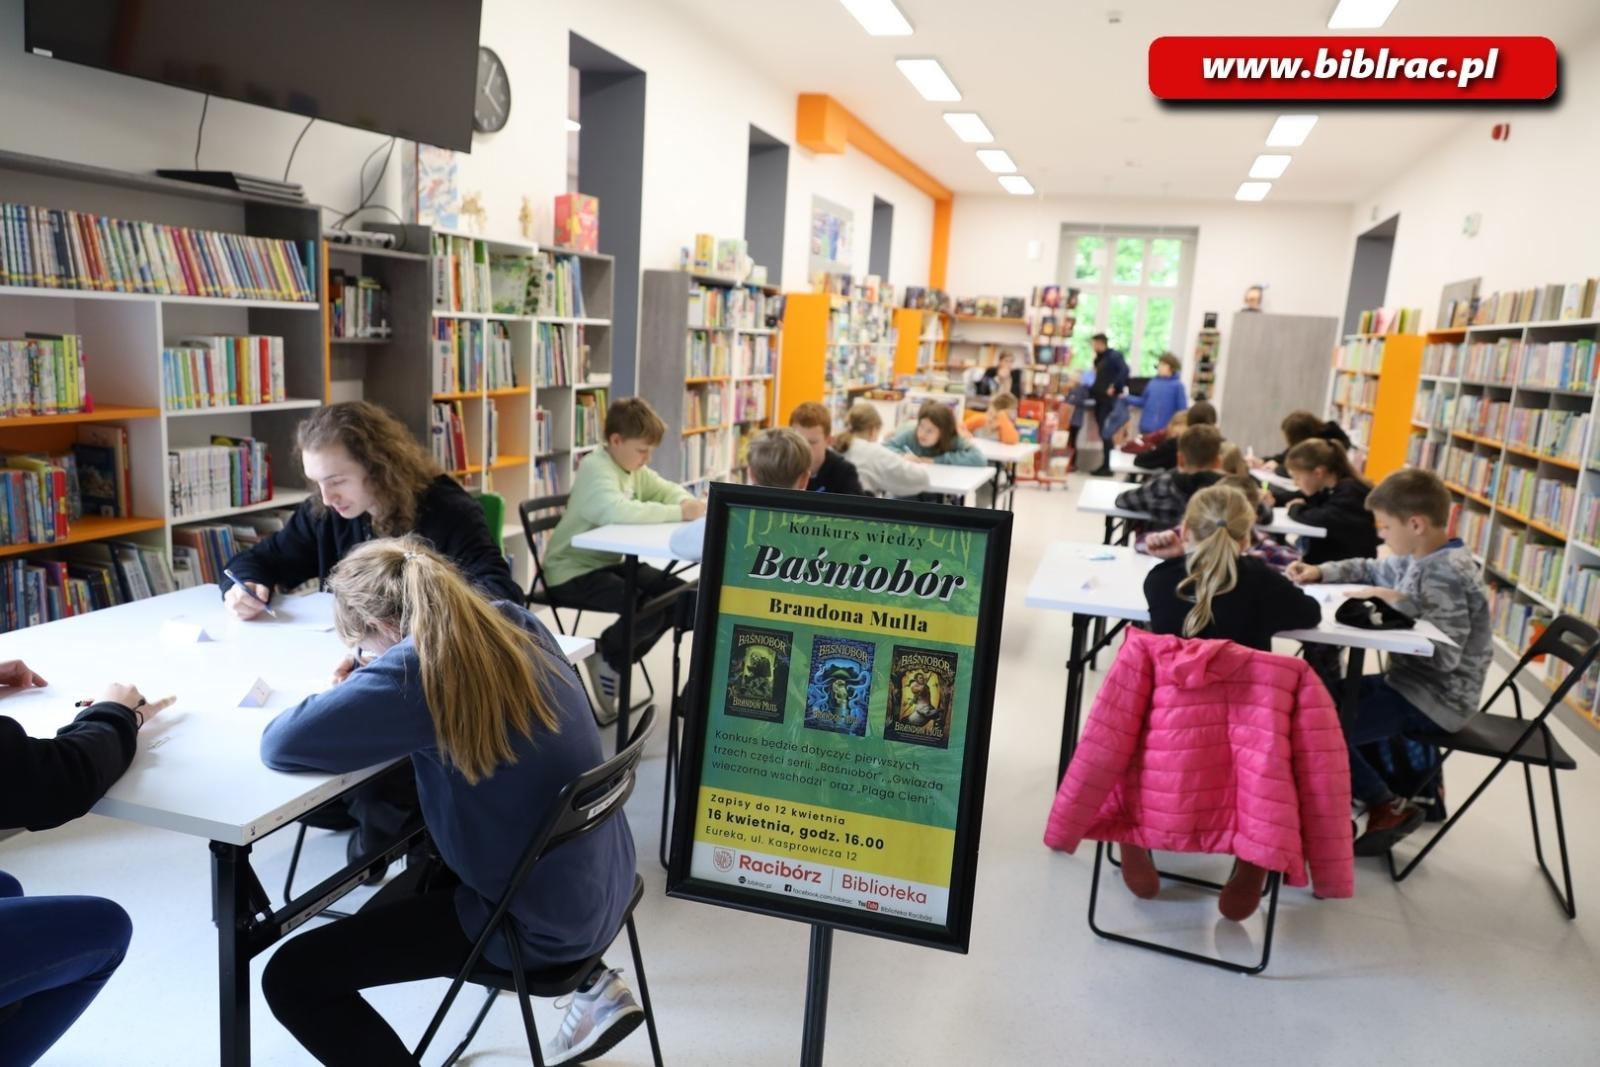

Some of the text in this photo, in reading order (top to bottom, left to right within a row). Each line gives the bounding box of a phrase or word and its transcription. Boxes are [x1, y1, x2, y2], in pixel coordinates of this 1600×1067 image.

[789, 521, 927, 550] Konkurs wiedzy
[749, 545, 967, 601] Baśniobór
[769, 597, 929, 633] Brandona Mulla
[713, 745, 747, 758] trzech
[750, 752, 784, 765] części
[715, 730, 920, 771] Konkurs będzie dotyczyć pierwszych
[712, 761, 767, 777] wieczorna
[829, 780, 854, 792] oraz
[710, 793, 845, 825] Zapisy do 12 kwietnia
[705, 825, 857, 862] Eureka, ul. Kasprowicza 12
[707, 808, 885, 850] 16 kwietnia, godz. 16.00
[739, 854, 928, 905] Racibórz Biblioteka
